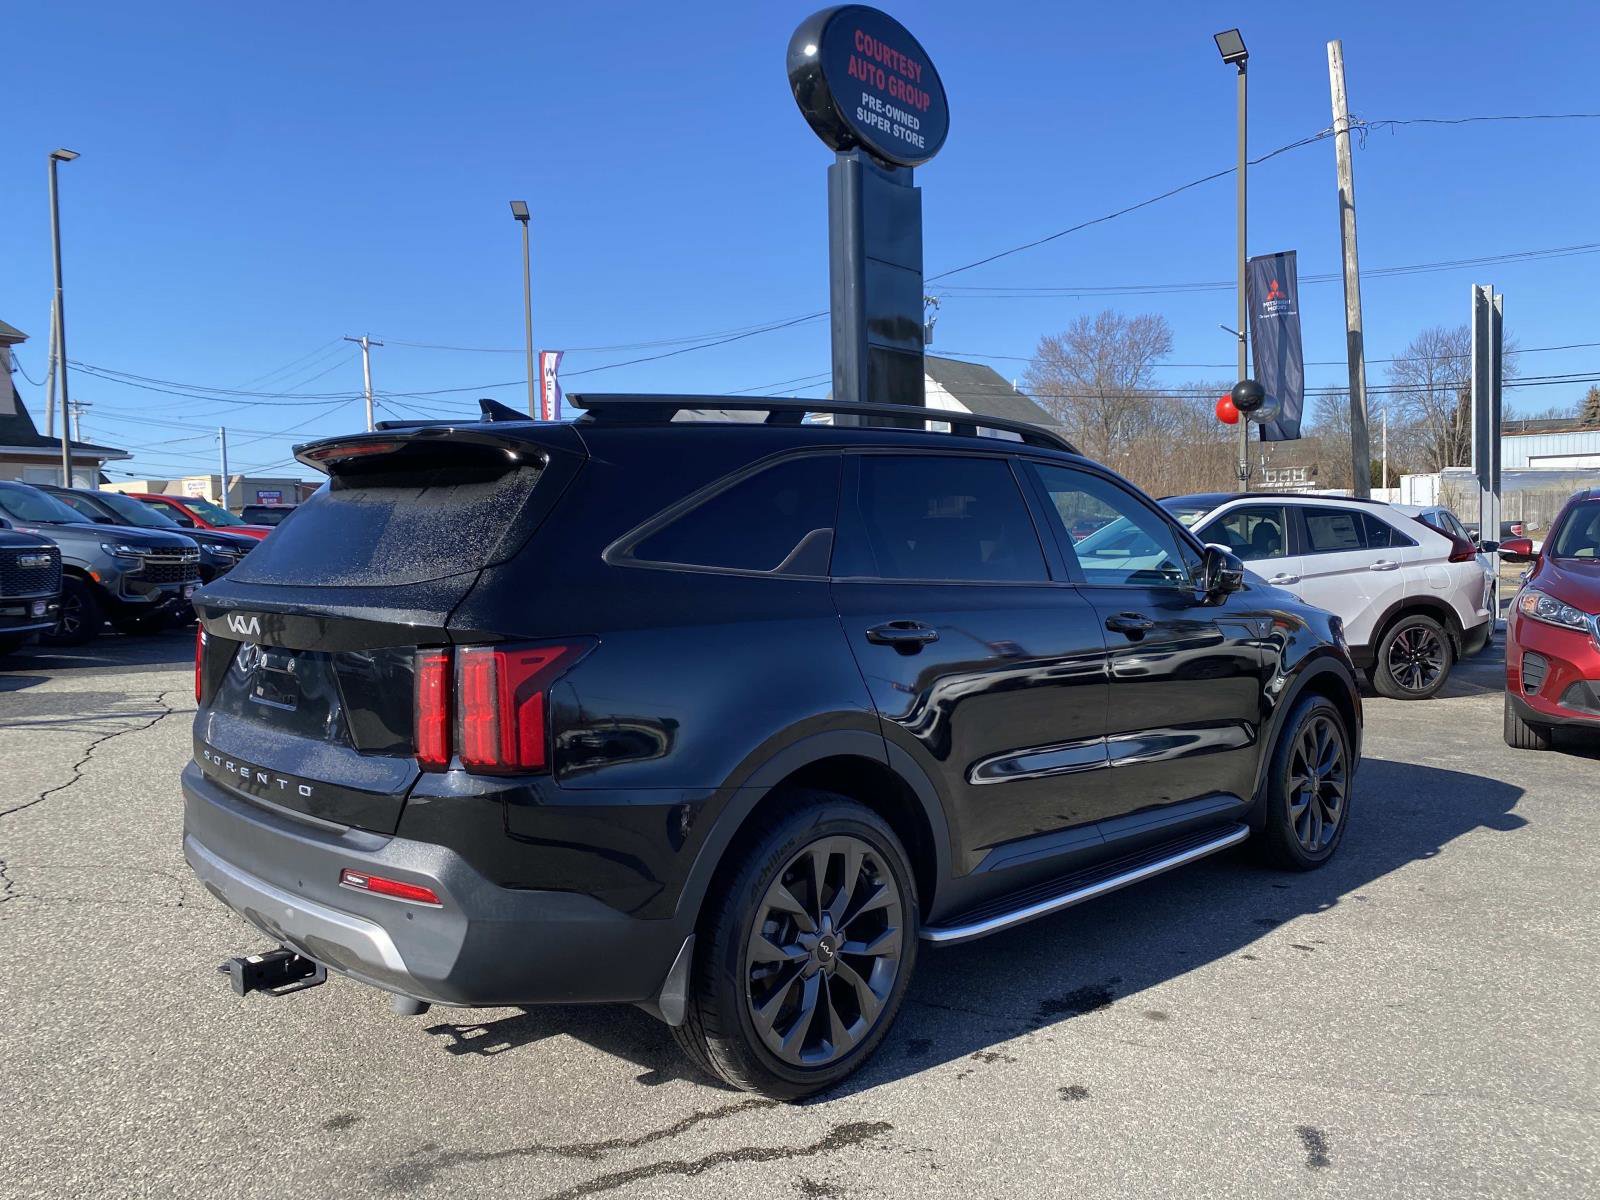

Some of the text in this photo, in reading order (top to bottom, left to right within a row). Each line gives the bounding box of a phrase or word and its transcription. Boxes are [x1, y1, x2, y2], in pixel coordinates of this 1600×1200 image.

[854, 29, 922, 84] COURTESY
[848, 54, 930, 113] AUTO GROUP
[856, 107, 925, 149] SUPER STORE
[861, 92, 920, 131] PRE-OWNED
[227, 614, 261, 635] KIA
[203, 750, 313, 797] SORENTO
